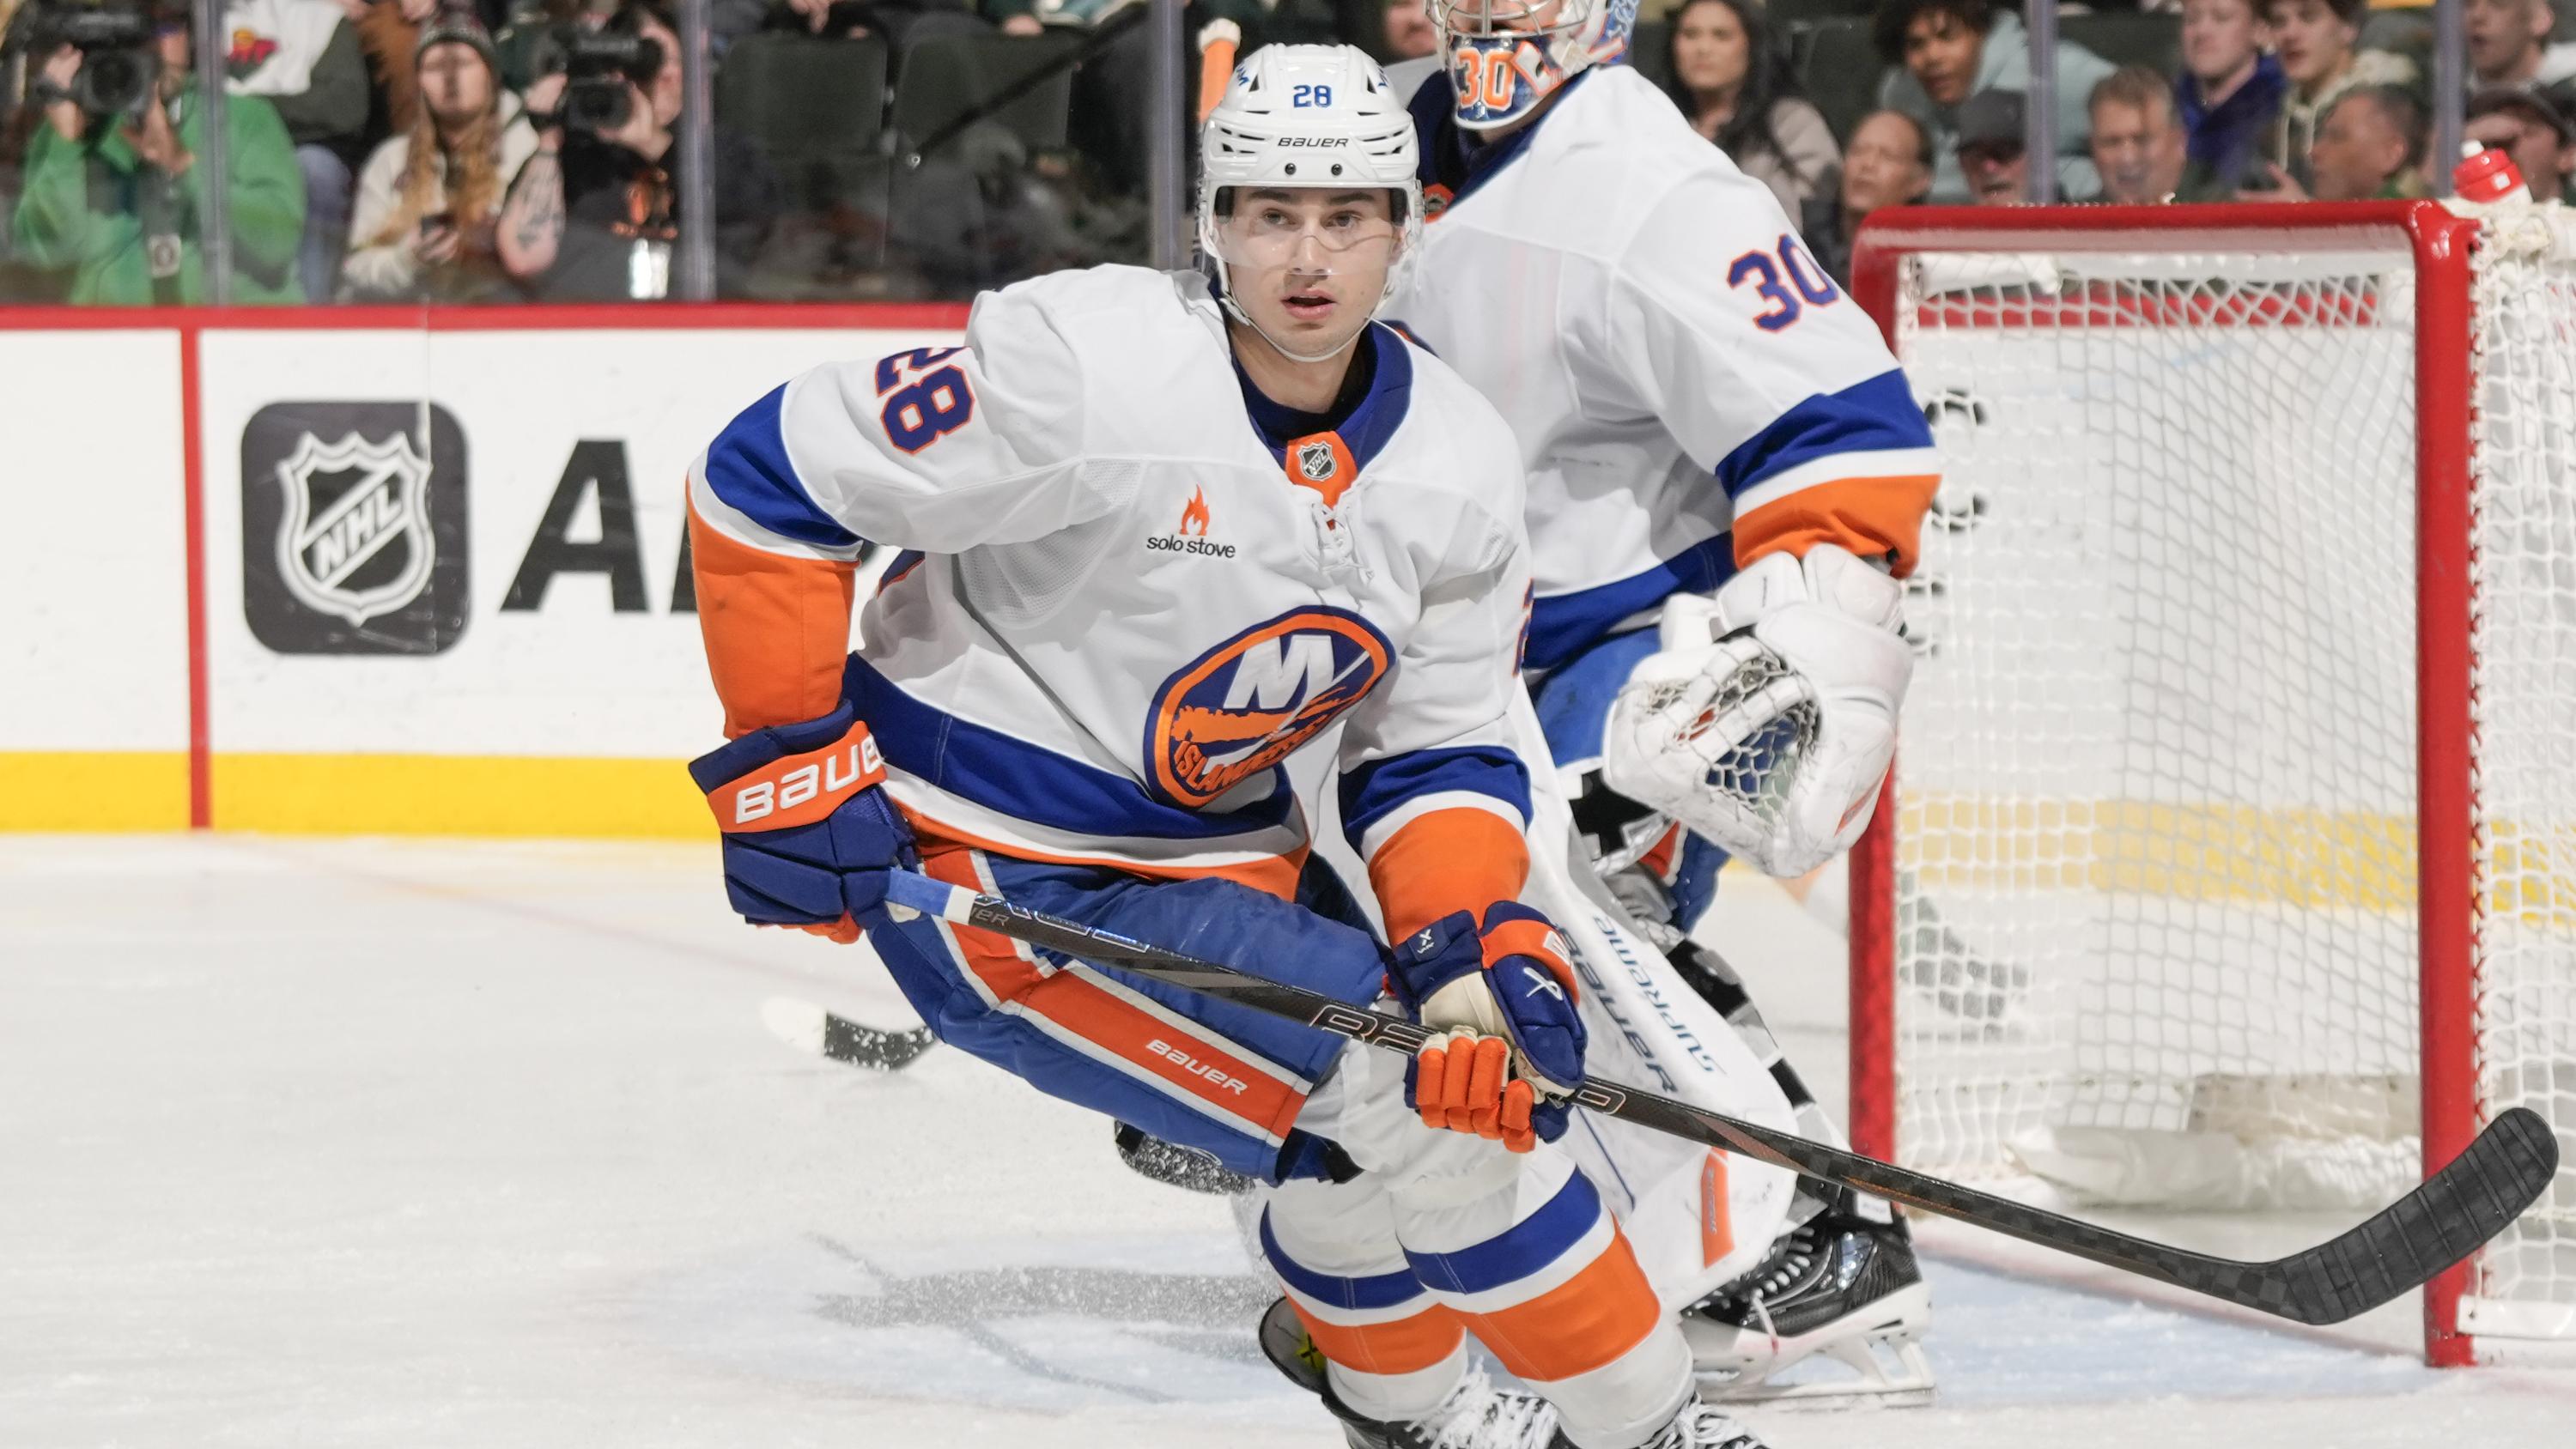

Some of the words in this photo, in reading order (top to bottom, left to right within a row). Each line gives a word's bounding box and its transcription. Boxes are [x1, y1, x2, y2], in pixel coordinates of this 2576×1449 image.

[1293, 84, 1332, 108] 28
[1455, 46, 1516, 112] 30
[1278, 136, 1349, 148] BAUER
[1726, 233, 1839, 334] 30
[313, 484, 404, 579] NHL
[499, 439, 699, 614] A
[1146, 534, 1184, 552] solo
[1187, 538, 1236, 559] stove
[736, 732, 882, 824] BAUE
[1594, 914, 1728, 1075] SUPREME
[1145, 1039, 1248, 1096] BAUER
